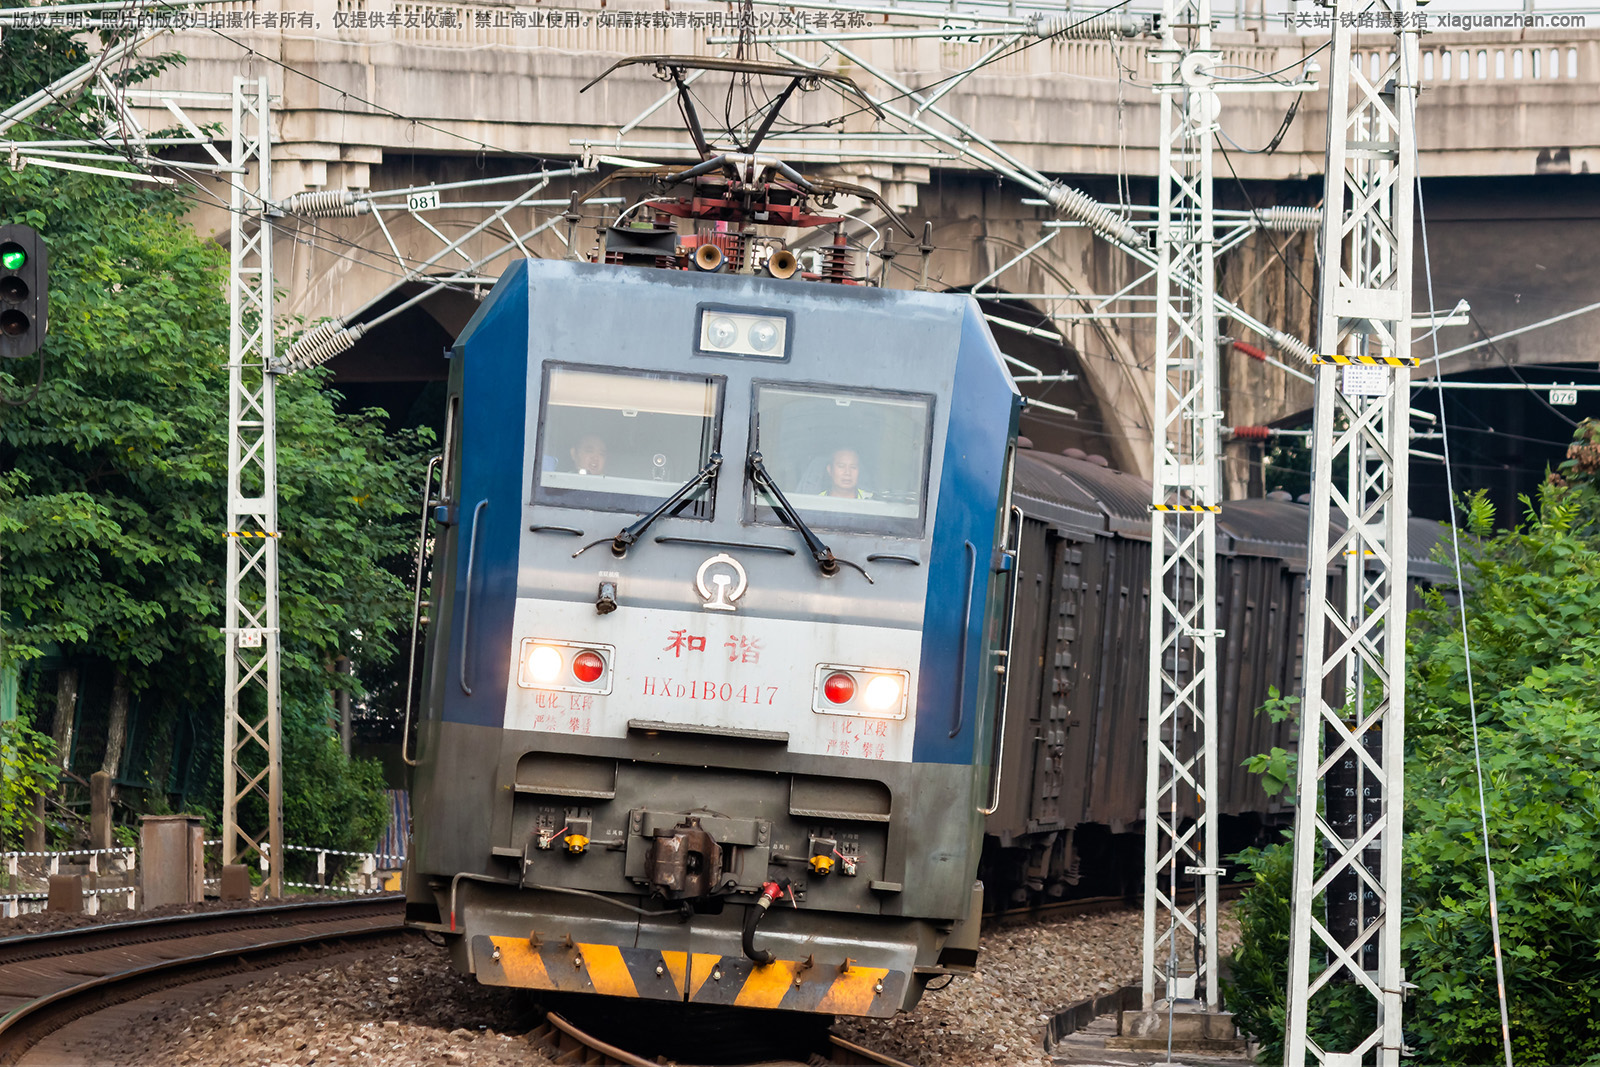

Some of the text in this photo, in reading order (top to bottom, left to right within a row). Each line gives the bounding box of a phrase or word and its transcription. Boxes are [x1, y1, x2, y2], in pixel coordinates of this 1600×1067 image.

[409, 195, 436, 210] 081
[1552, 392, 1575, 403] 076
[662, 629, 766, 664] 和谐
